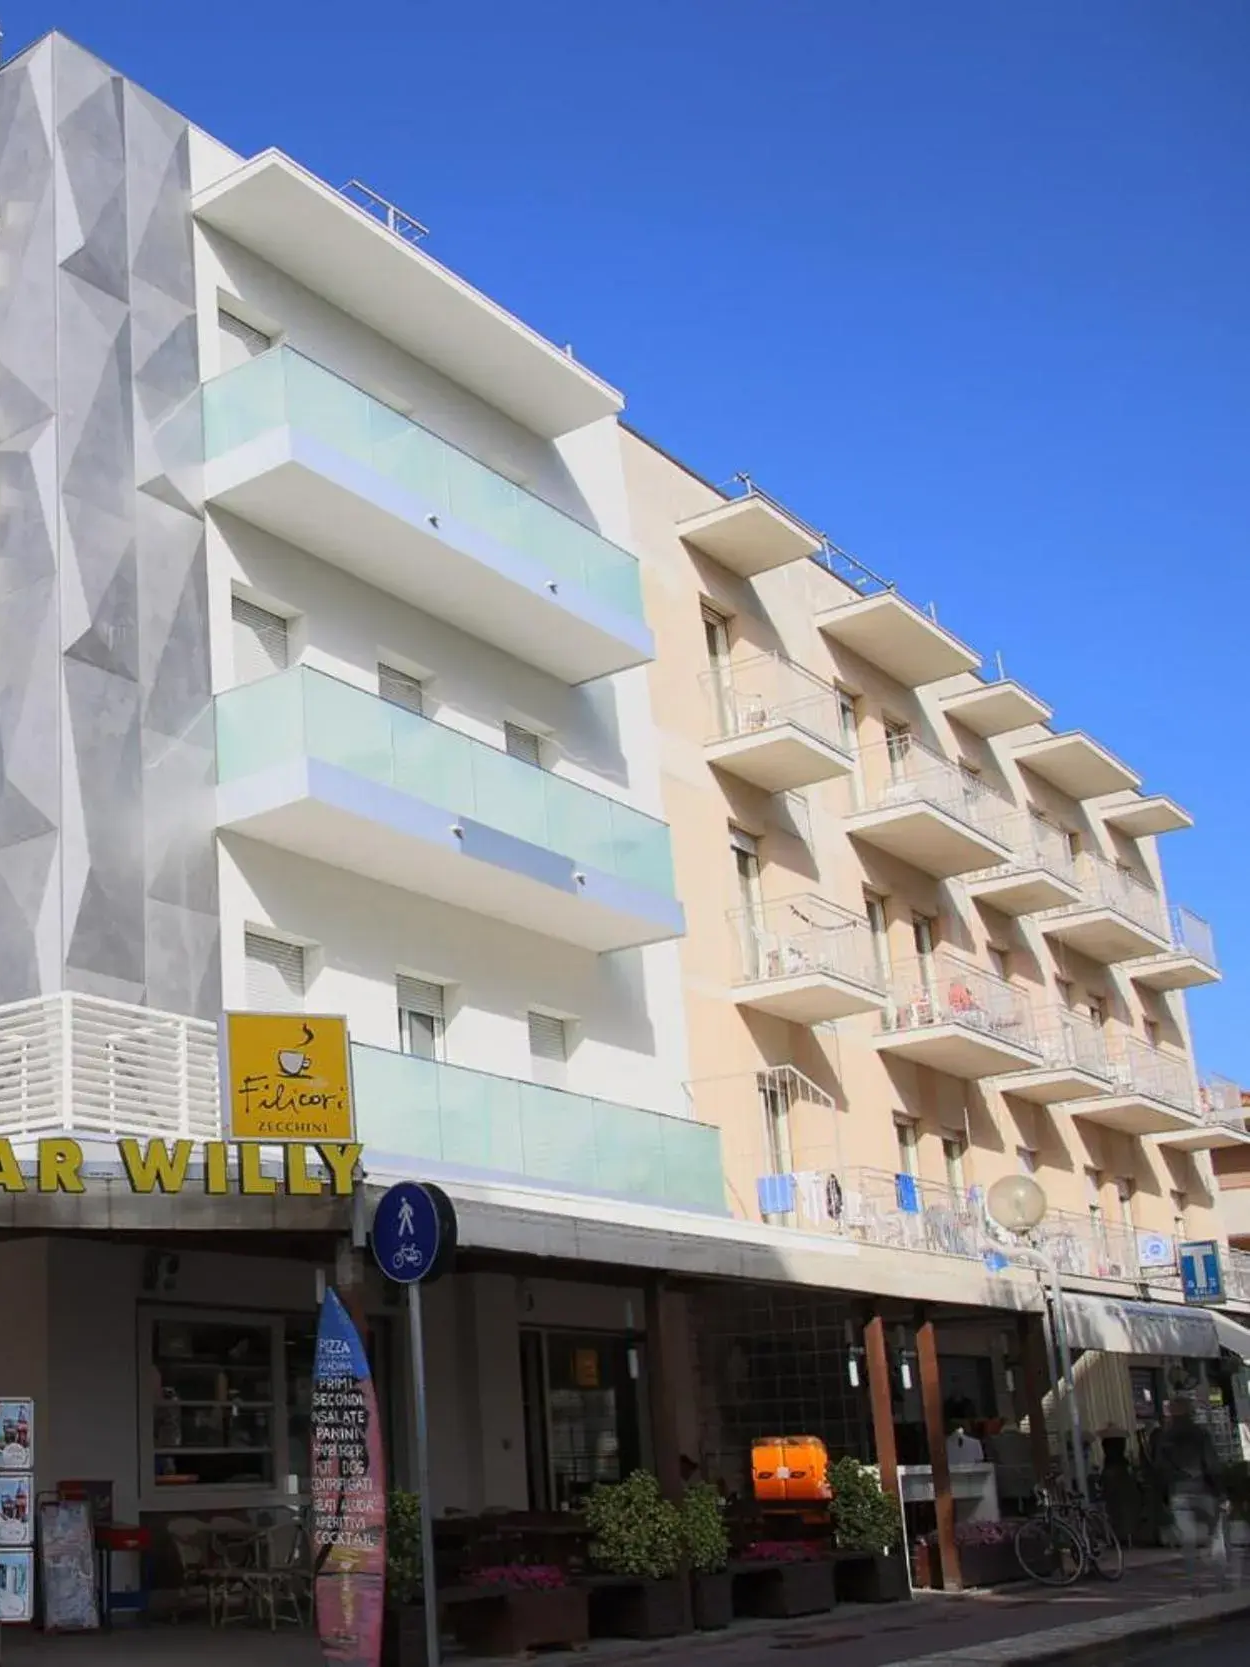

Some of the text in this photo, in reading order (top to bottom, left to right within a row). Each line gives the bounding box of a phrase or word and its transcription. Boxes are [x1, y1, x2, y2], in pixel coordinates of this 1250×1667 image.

[237, 1074, 346, 1115] Filicori
[257, 1121, 329, 1134] ZECCHINI
[117, 1138, 364, 1196] WILLY
[318, 1338, 351, 1354] PIZZA
[319, 1377, 353, 1391] PRIMI
[312, 1392, 363, 1406] SECONDI
[313, 1460, 365, 1474] HOT DOG
[314, 1530, 375, 1546] COCKTAIL
